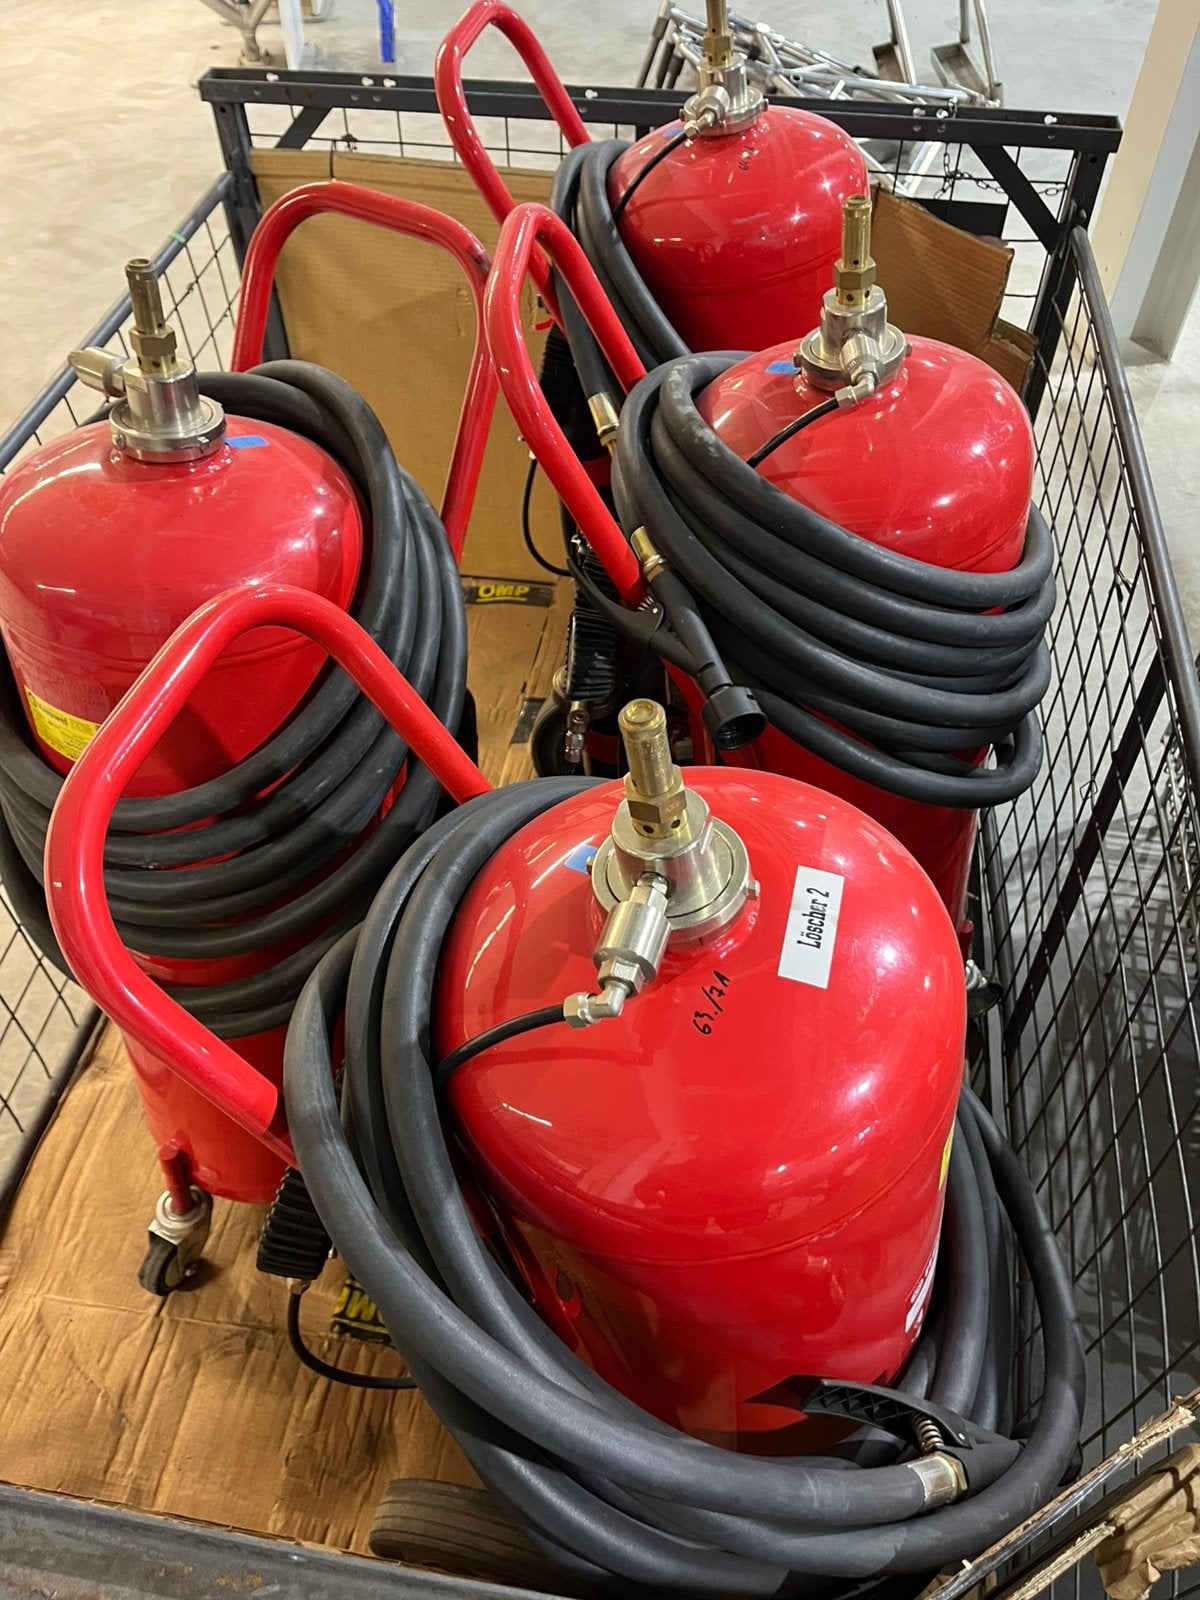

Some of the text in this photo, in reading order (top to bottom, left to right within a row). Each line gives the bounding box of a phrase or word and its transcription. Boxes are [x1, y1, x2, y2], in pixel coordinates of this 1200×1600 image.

[478, 584, 530, 598] OMP
[796, 887, 830, 949] Löscher 2
